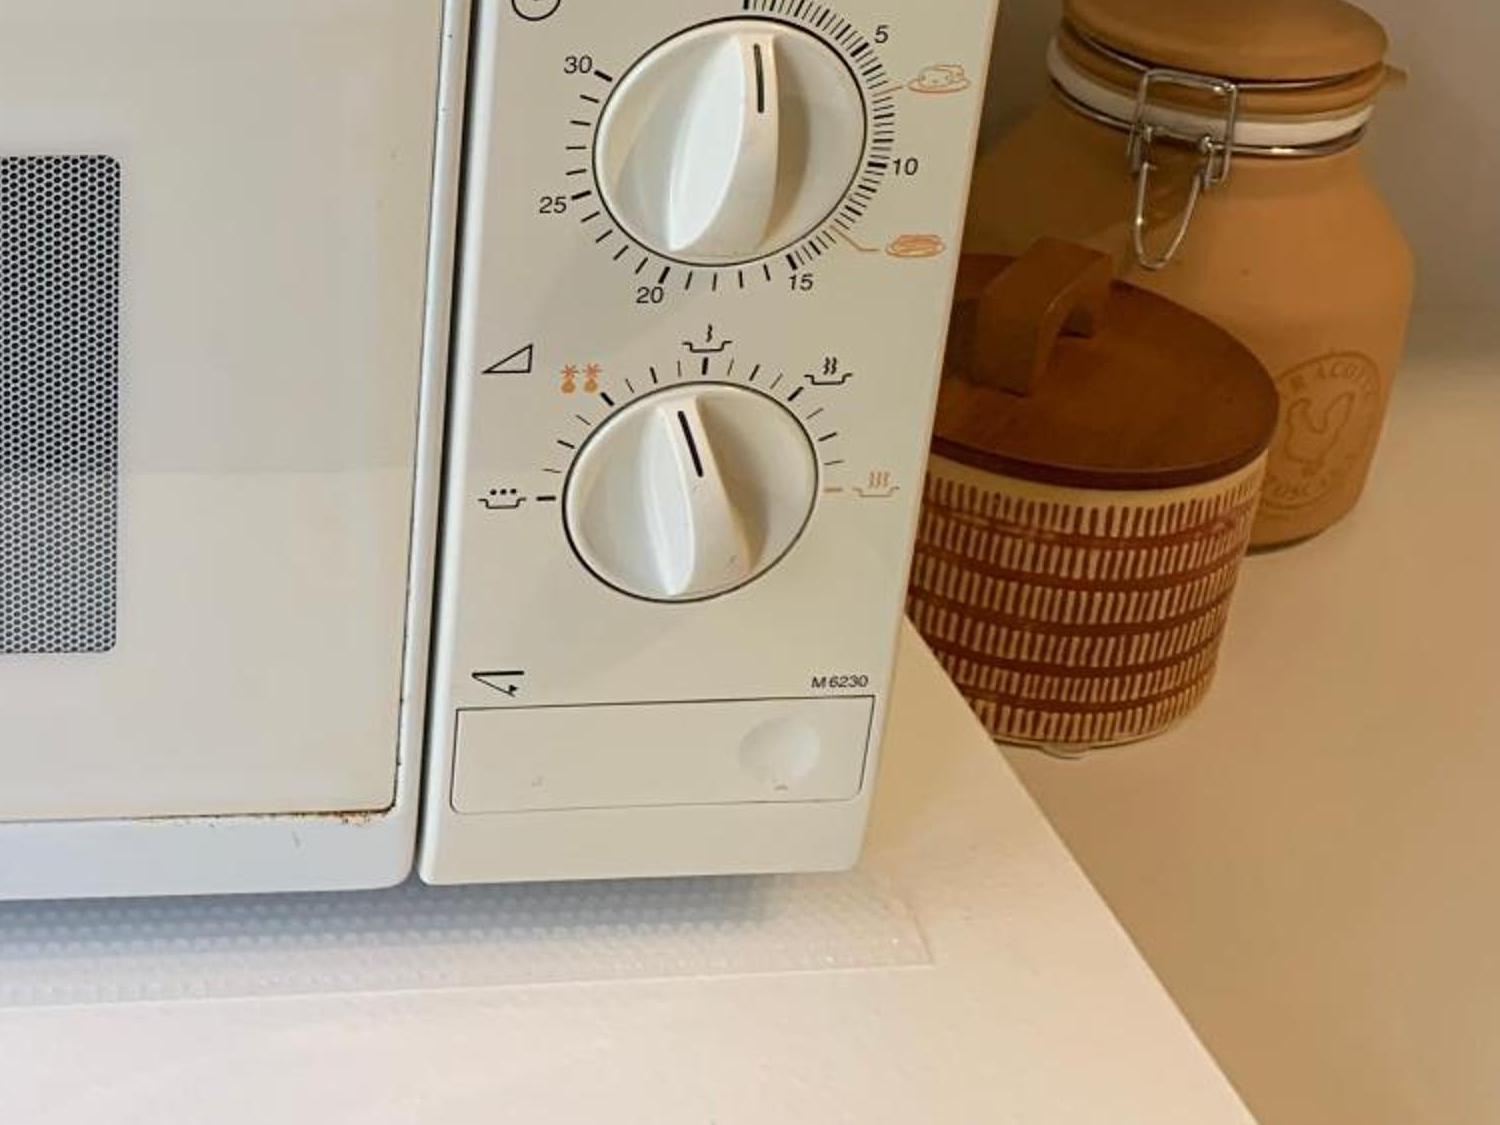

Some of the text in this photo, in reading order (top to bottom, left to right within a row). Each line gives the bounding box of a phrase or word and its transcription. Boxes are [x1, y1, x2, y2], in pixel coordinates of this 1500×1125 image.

[874, 25, 889, 44] 5
[563, 55, 592, 74] 30
[893, 157, 919, 176] 10
[539, 196, 567, 214] 25
[790, 274, 813, 291] 15
[636, 286, 664, 304] 20
